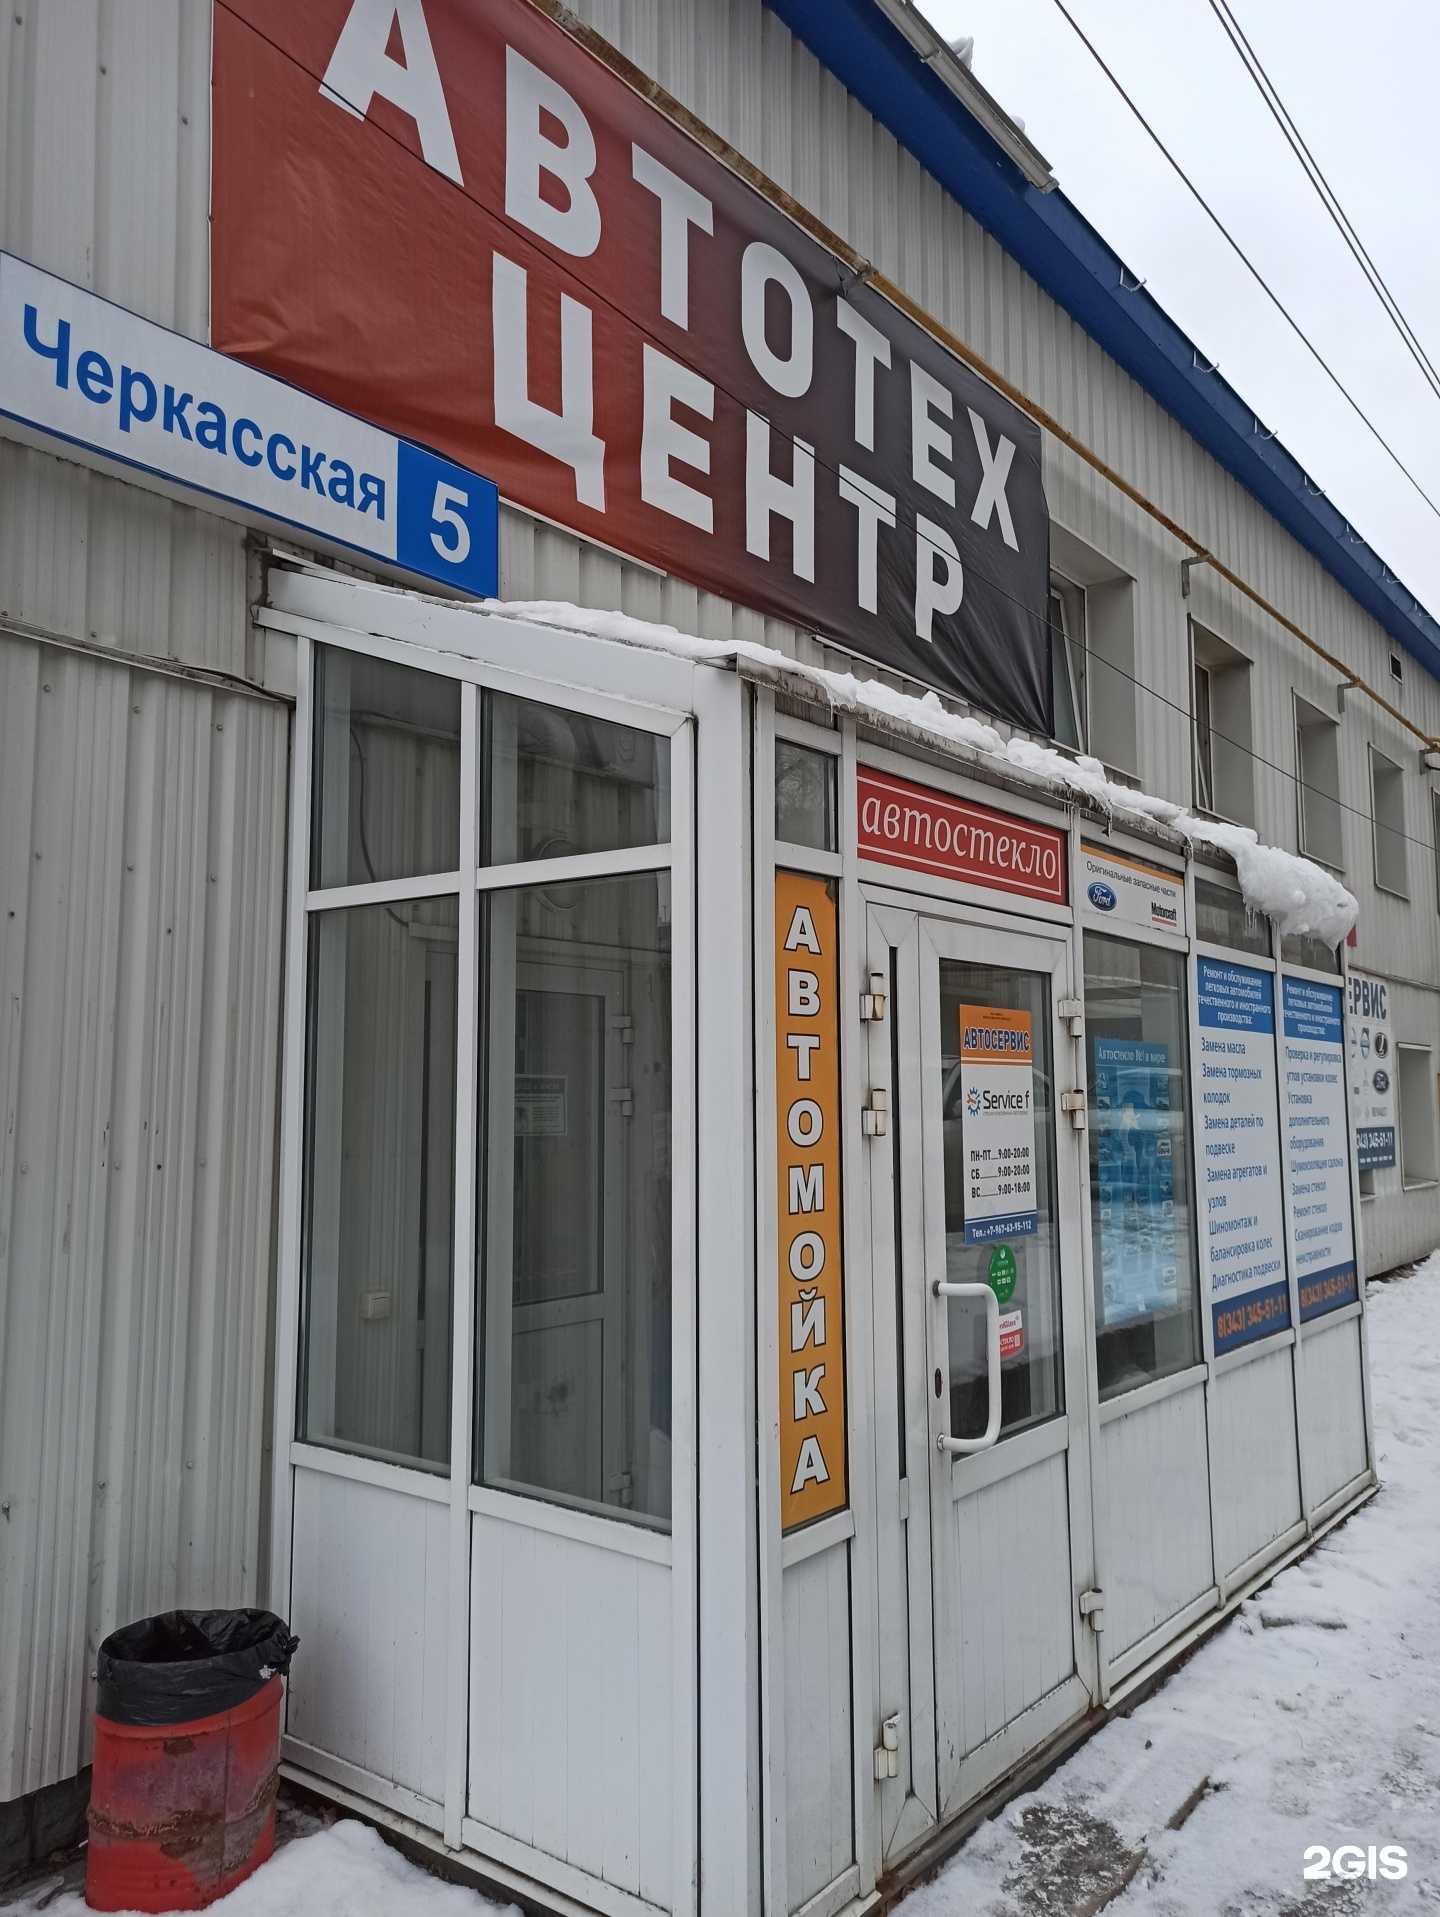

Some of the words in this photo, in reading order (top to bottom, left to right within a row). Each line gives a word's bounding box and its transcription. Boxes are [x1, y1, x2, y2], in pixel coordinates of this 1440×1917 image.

[318, 0, 1019, 553] АВТОТЕХ
[23, 303, 387, 521] Черкасская
[430, 480, 471, 564] 5
[492, 250, 964, 643] ЦЕНТР
[861, 796, 1057, 880] автостекло
[1090, 884, 1115, 909] Ford
[1203, 965, 1223, 979] Ремонт
[1198, 995, 1234, 1009] течественного
[964, 1027, 1030, 1051] АВТОСЕРВИС
[1201, 1037, 1226, 1053] Замена
[1227, 1042, 1246, 1054] масла
[1202, 1063, 1227, 1078] Замена
[1227, 1067, 1262, 1082] тормозных
[983, 1090, 1023, 1110] Service
[1025, 1089, 1030, 1109] f
[1203, 1092, 1231, 1105] колодок
[1204, 1115, 1229, 1130] Замена
[1230, 1113, 1255, 1130] деталей
[1256, 1117, 1264, 1128] по
[1206, 1143, 1236, 1157] подвеске
[1207, 1167, 1232, 1183] Замена
[1232, 1165, 1262, 1182] агрегатов
[783, 904, 830, 1495] АВТОМОЙКА
[1208, 1194, 1227, 1213] узлов
[1209, 1216, 1253, 1235] Шиномонтаж
[1253, 1215, 1258, 1226] и
[1210, 1240, 1255, 1262] балансировка
[1256, 1236, 1273, 1251] колес
[1211, 1268, 1253, 1292] Диагностика
[1253, 1260, 1281, 1277] подвески
